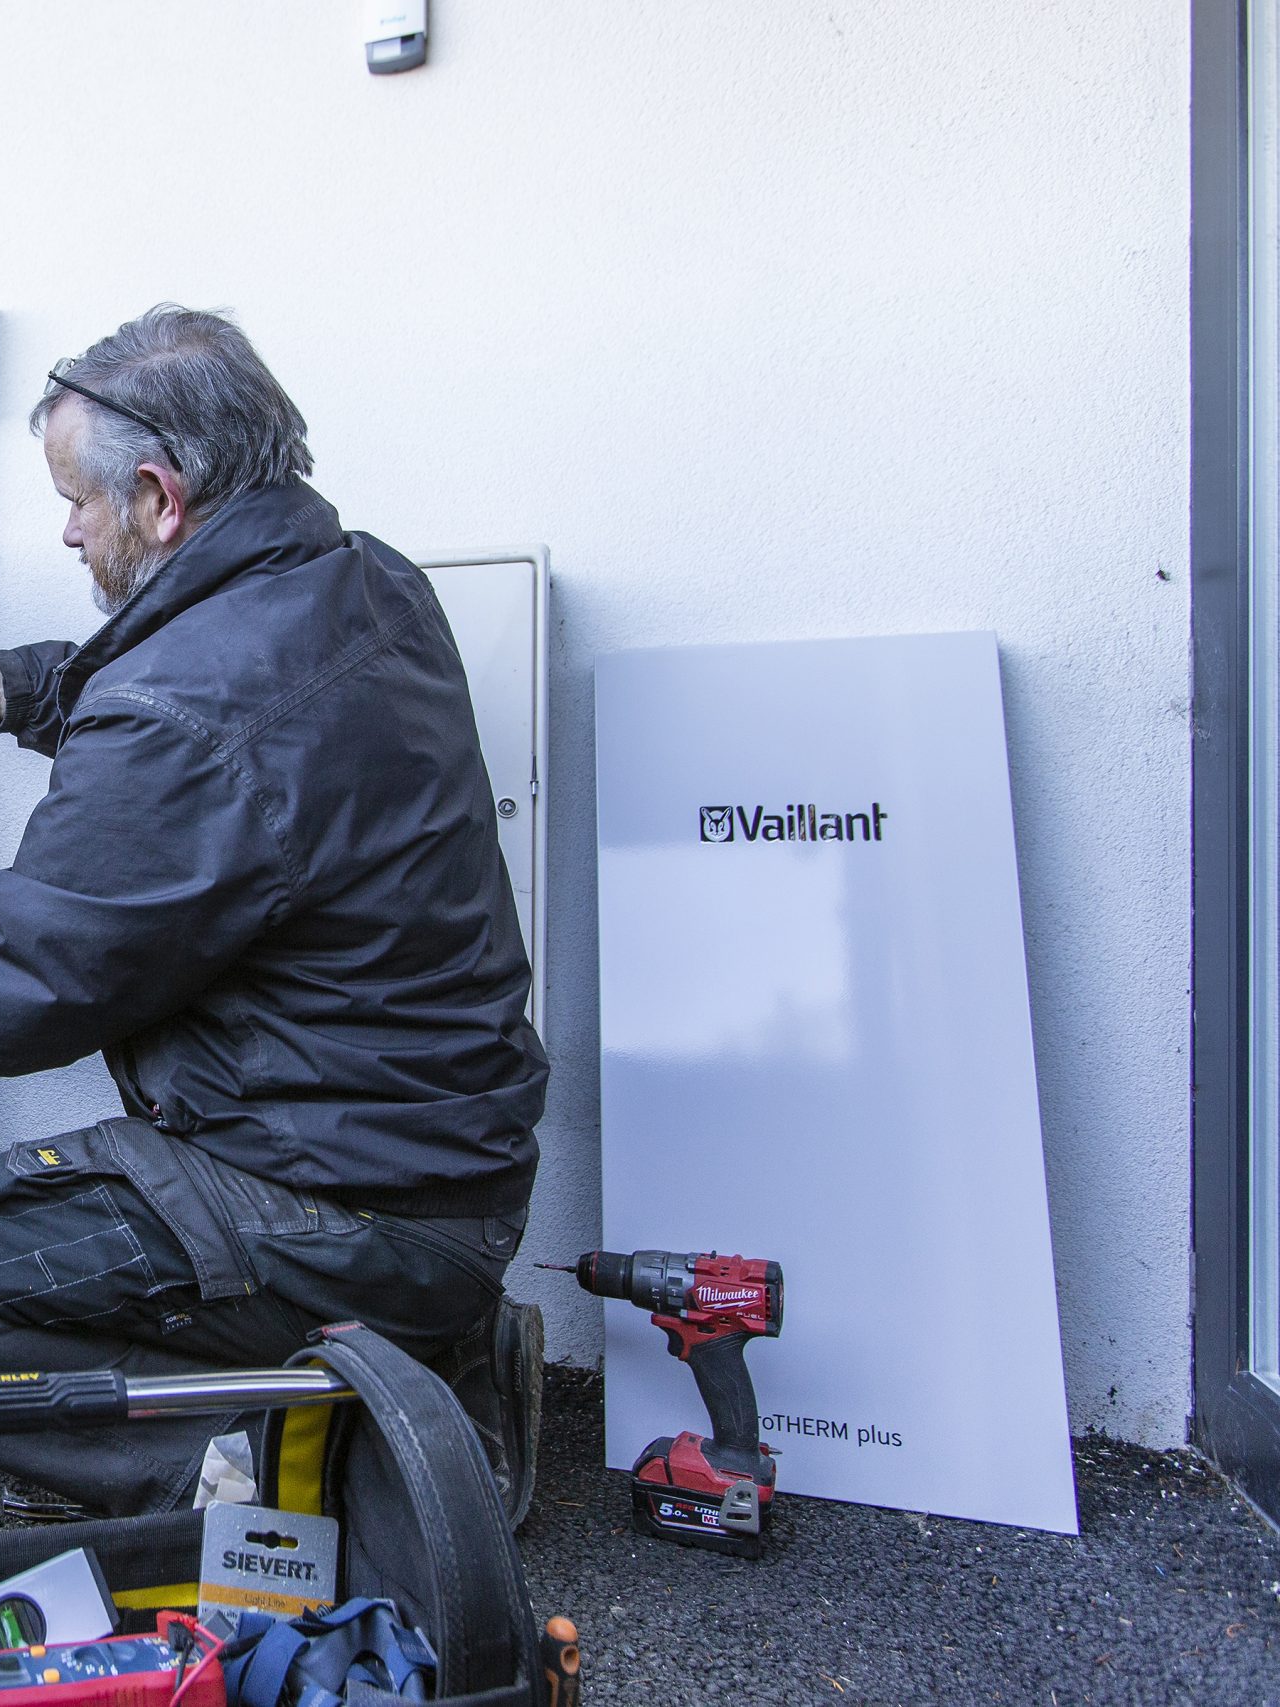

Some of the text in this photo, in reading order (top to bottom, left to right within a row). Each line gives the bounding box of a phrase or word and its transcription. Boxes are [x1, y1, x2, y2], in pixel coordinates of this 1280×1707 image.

[736, 802, 888, 842] Vaillant
[696, 1286, 759, 1303] Milwaukee
[736, 1311, 764, 1320] FUEL
[757, 1413, 903, 1447] oTHERM plus
[659, 1502, 682, 1516] 5.0
[674, 1502, 719, 1516] REDLITHI
[703, 1515, 719, 1525] M1
[222, 1550, 315, 1580] SIEVERT
[268, 1597, 286, 1609] Line
